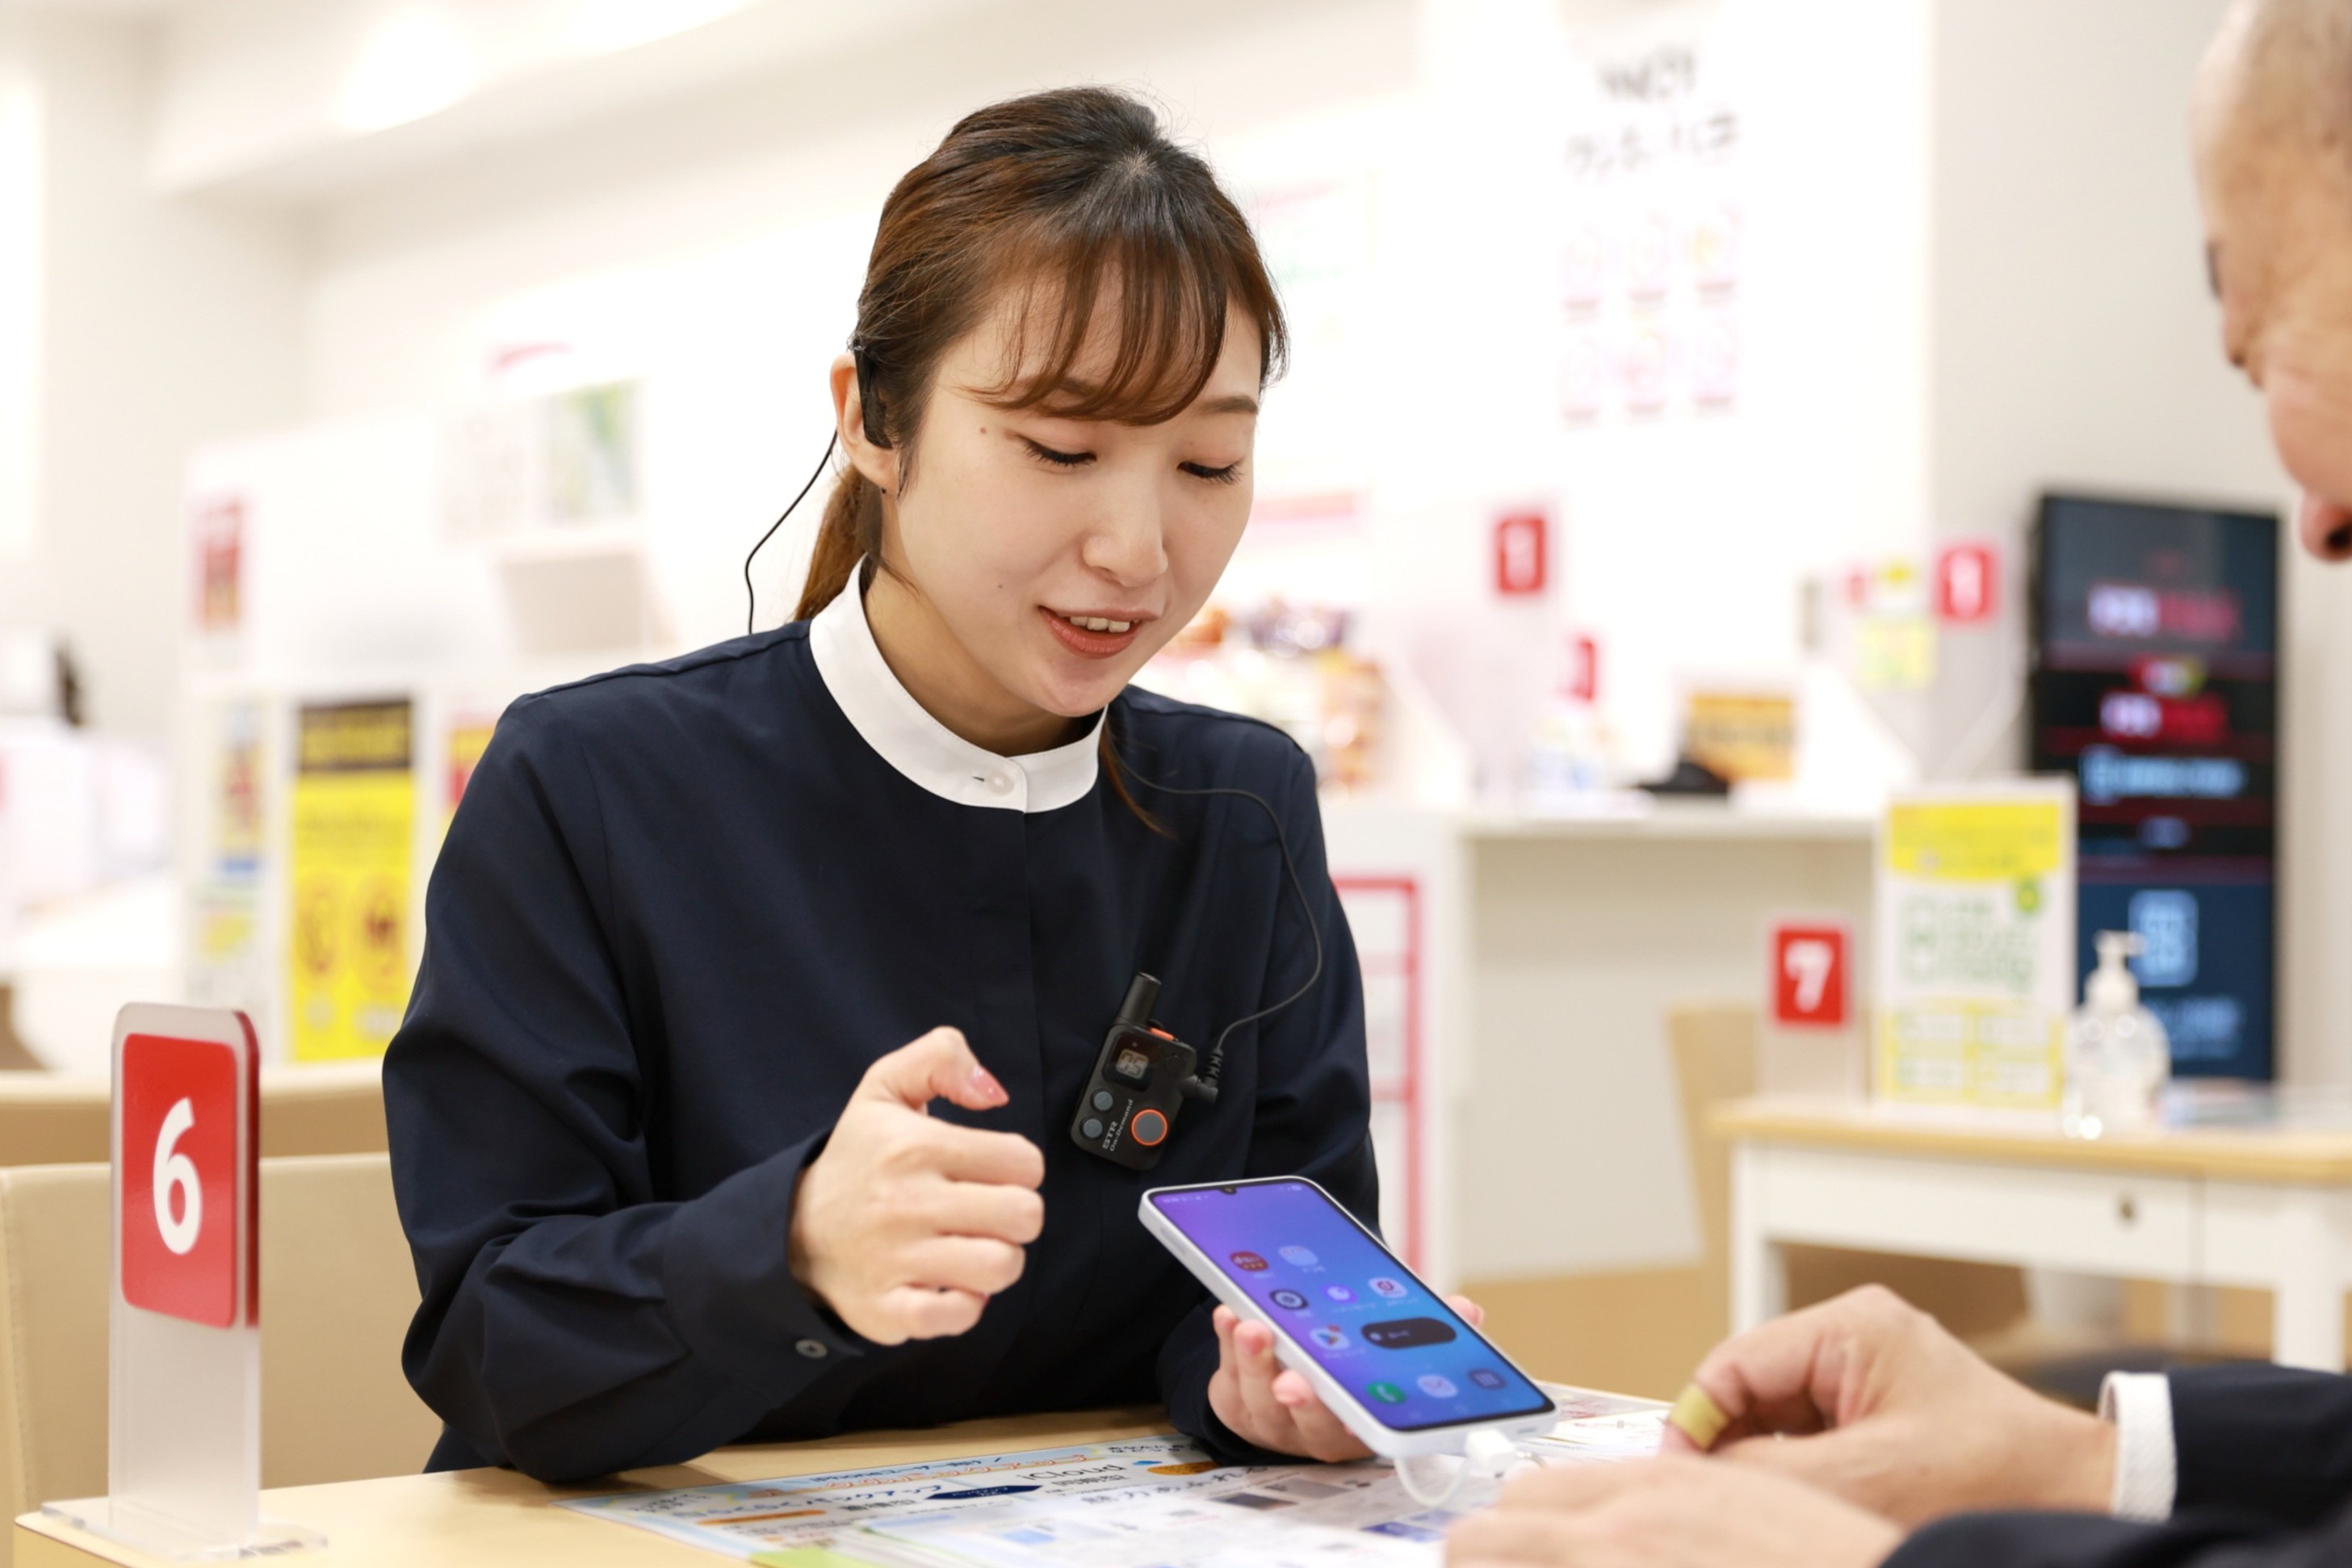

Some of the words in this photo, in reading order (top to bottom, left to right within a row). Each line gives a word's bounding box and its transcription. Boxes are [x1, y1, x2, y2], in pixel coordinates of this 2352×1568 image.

[1784, 939, 1834, 1012] 7
[1102, 1121, 1118, 1150] STR
[1109, 1098, 1134, 1151] On-Demand
[153, 1096, 202, 1255] 6
[1017, 1464, 1127, 1481] iCloud
